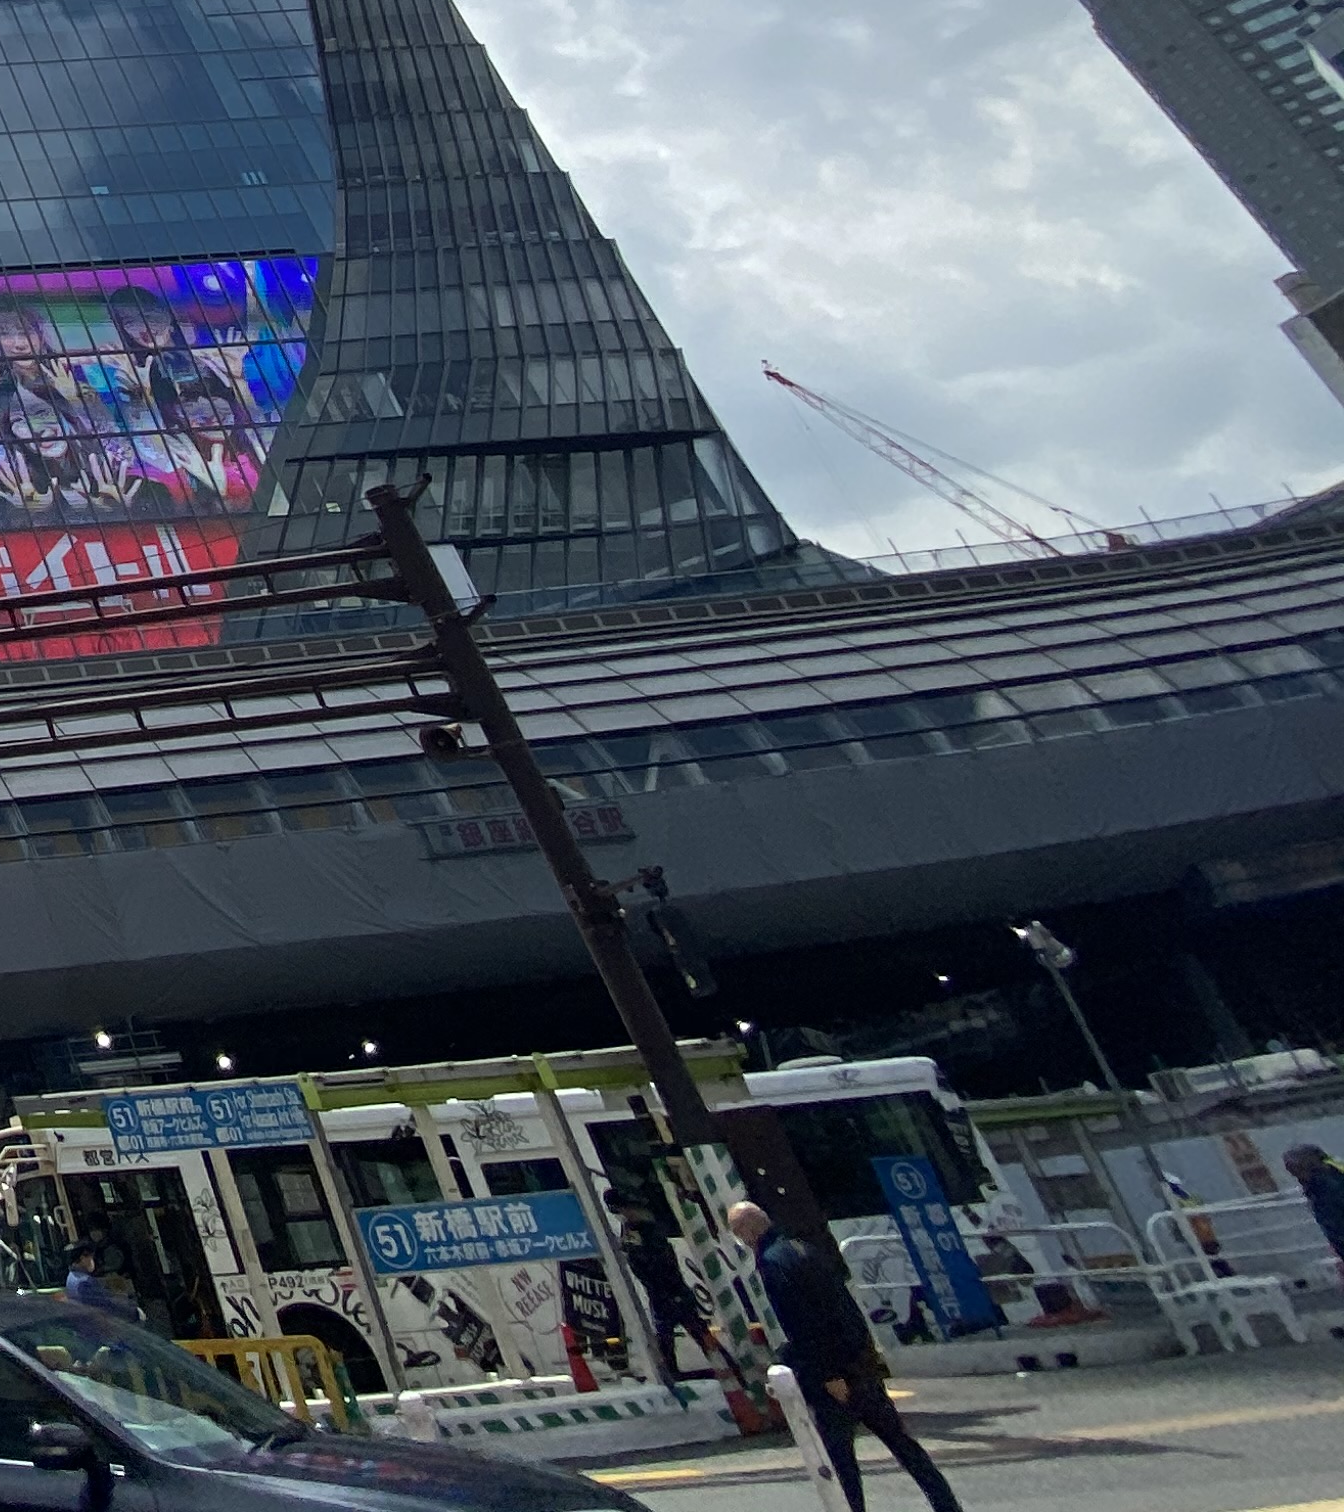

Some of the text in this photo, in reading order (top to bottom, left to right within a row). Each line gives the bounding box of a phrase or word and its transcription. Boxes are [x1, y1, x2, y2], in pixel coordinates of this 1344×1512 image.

[112, 1107, 135, 1128] 51
[211, 1098, 233, 1120] 51
[413, 1201, 539, 1243] 新橋駅前
[374, 1223, 412, 1259] 51
